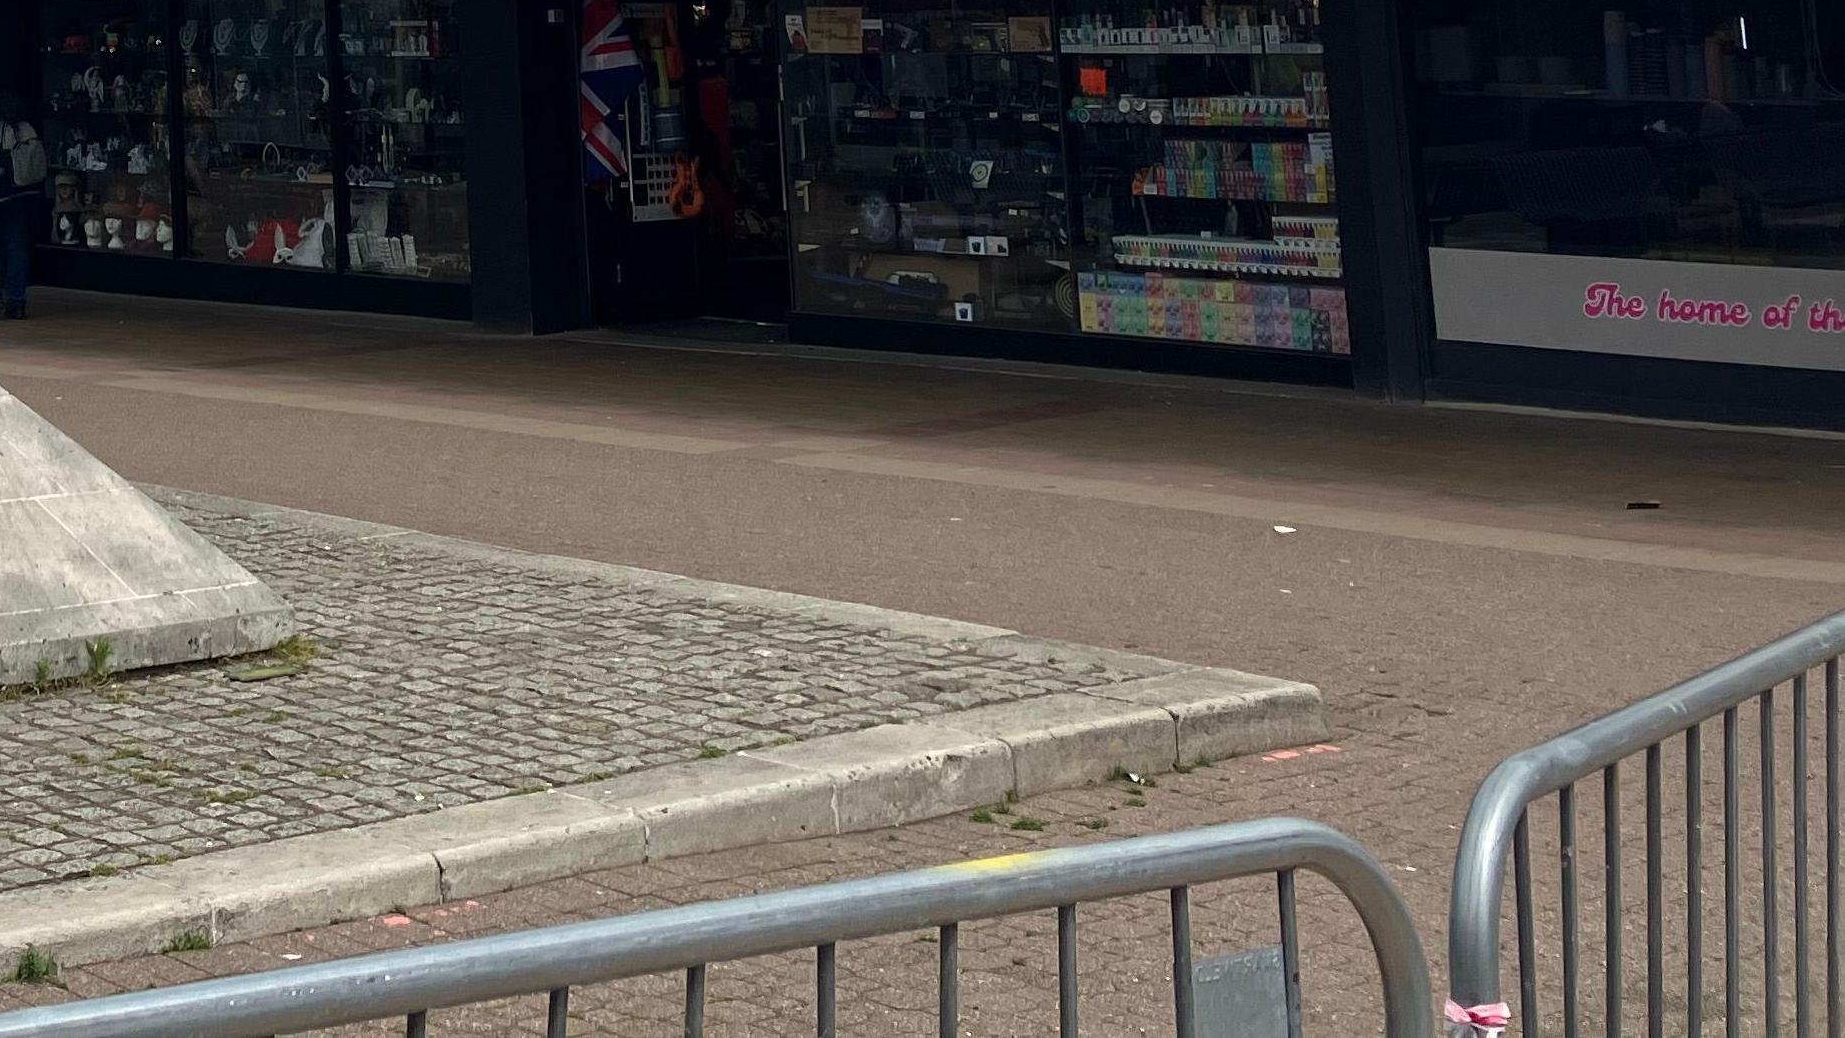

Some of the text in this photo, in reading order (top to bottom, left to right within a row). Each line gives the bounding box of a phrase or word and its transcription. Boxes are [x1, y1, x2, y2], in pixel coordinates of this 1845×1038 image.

[1583, 282, 1845, 333] The home of th
